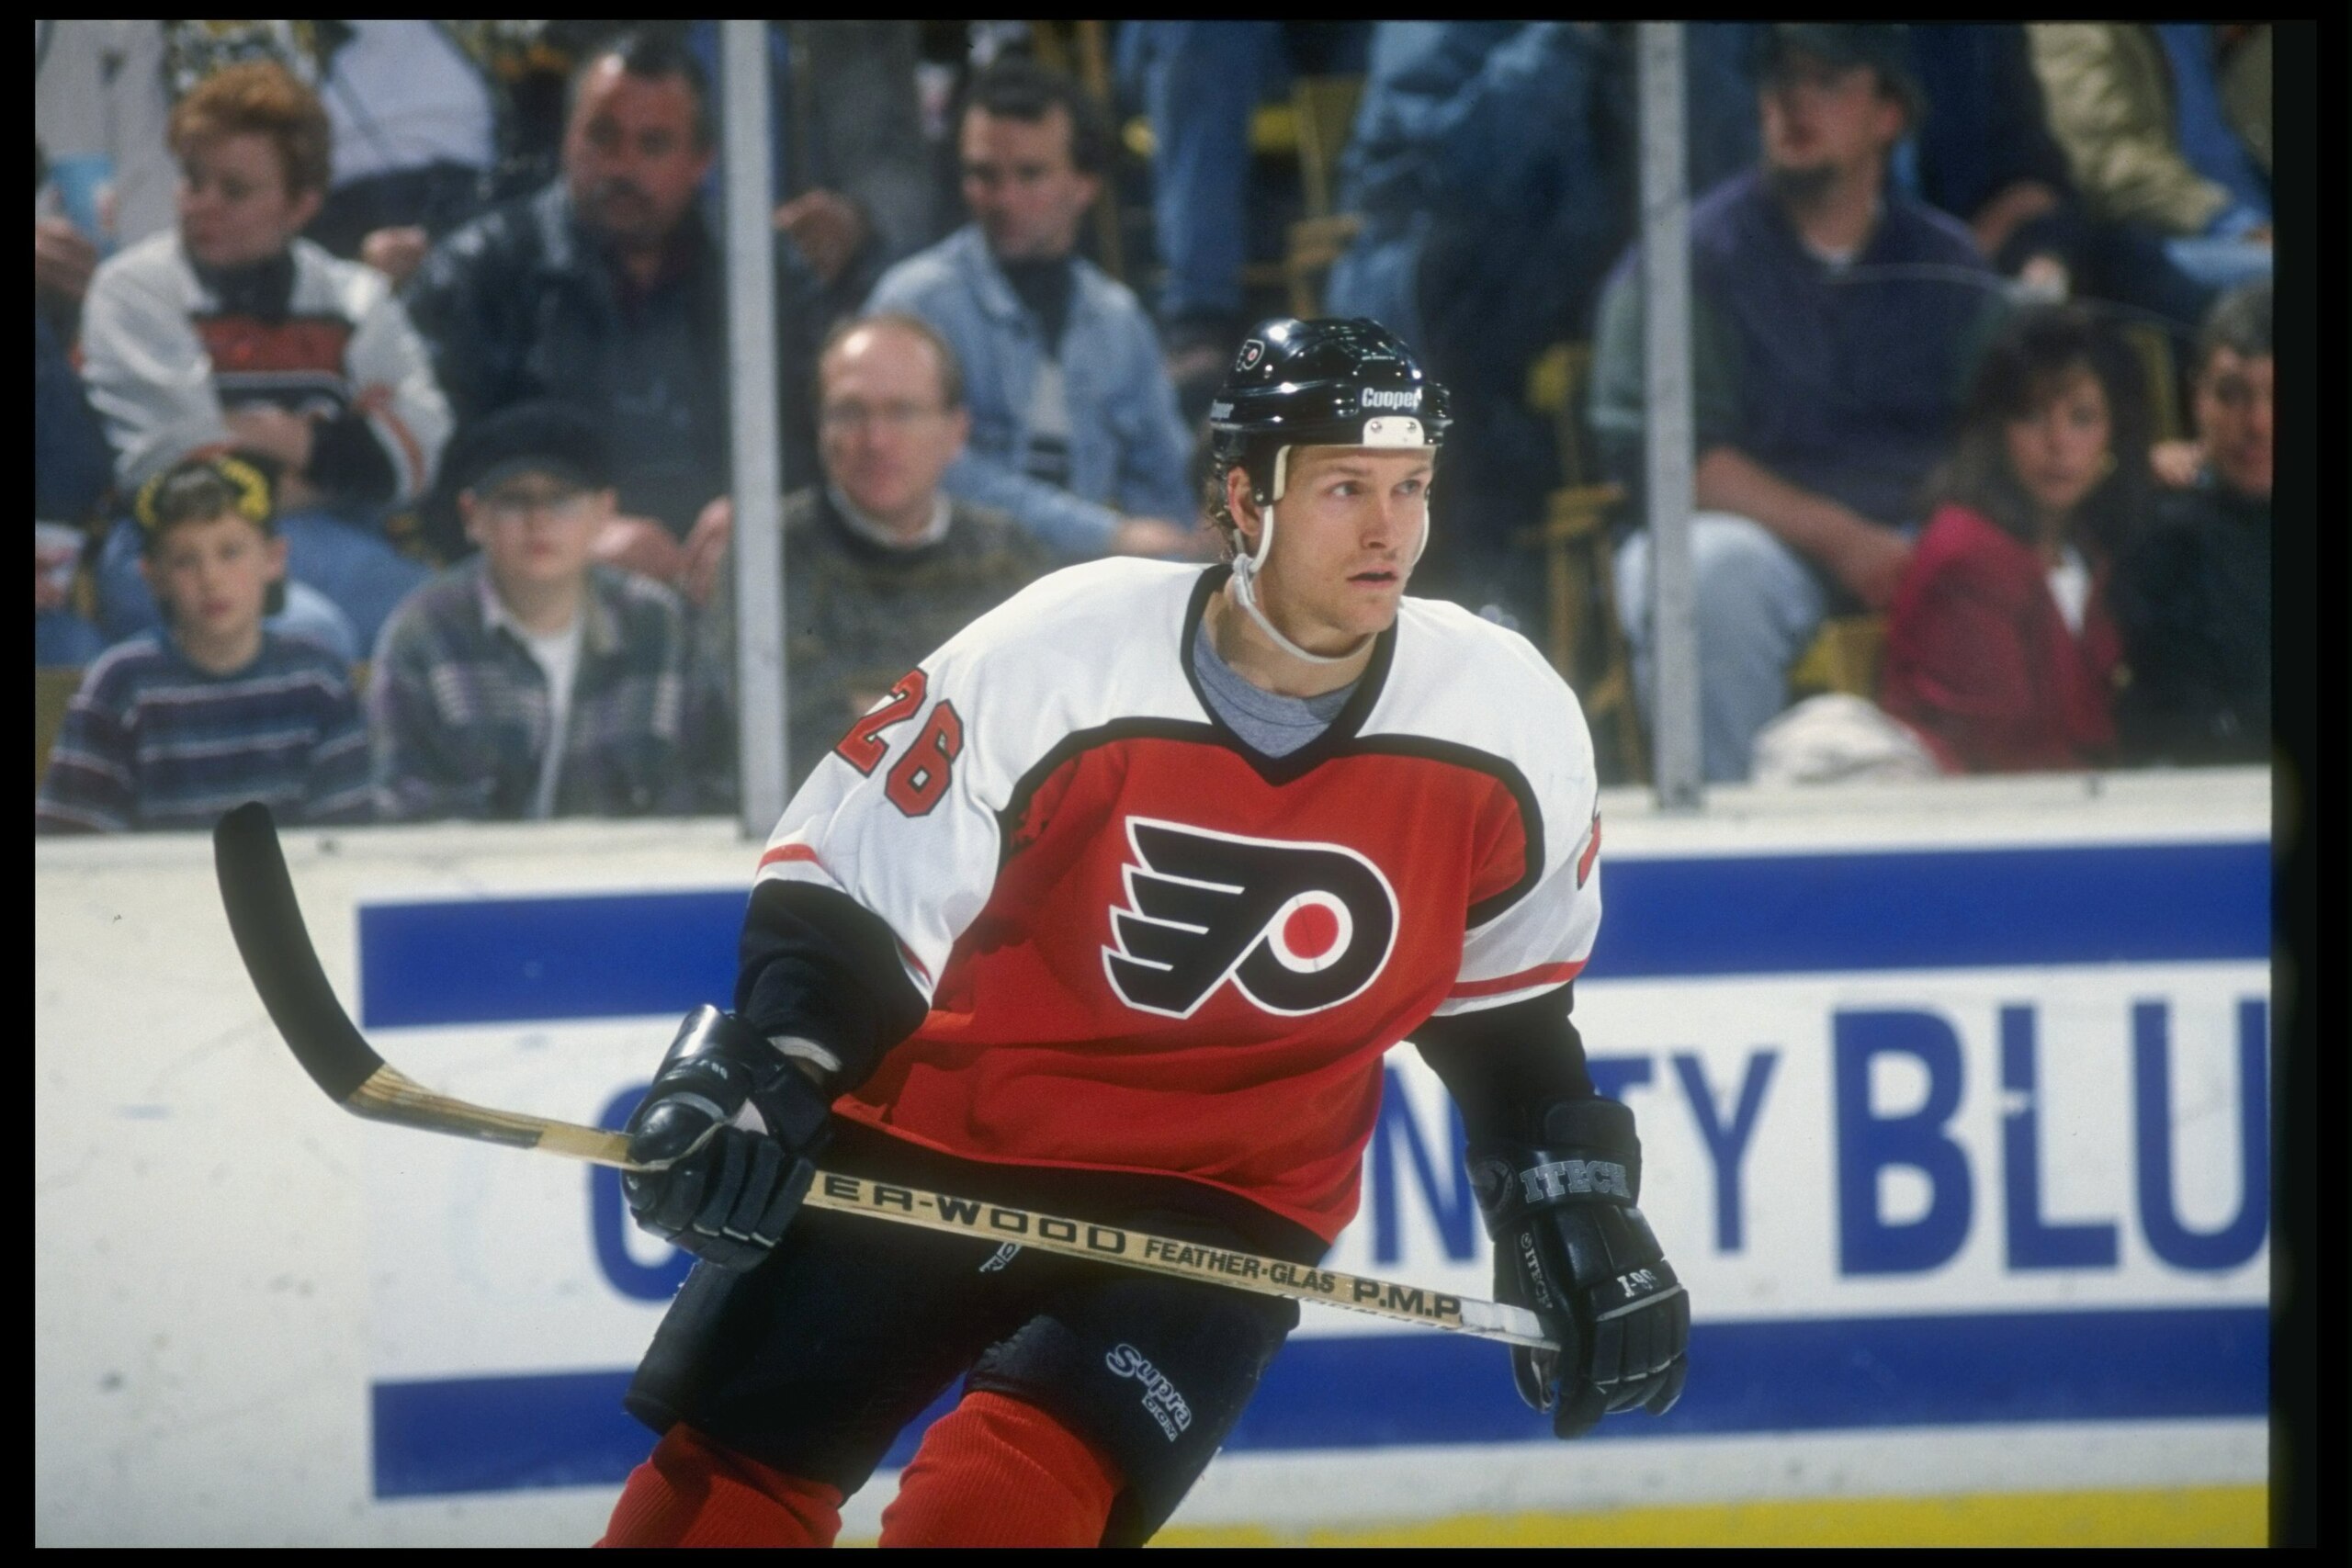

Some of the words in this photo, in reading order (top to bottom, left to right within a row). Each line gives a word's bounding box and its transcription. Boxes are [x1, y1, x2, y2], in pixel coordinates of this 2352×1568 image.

[1362, 387, 1423, 411] Cooper
[833, 666, 965, 818] 26
[1831, 998, 2267, 1280] BLU
[1105, 1343, 1192, 1432] Supra
